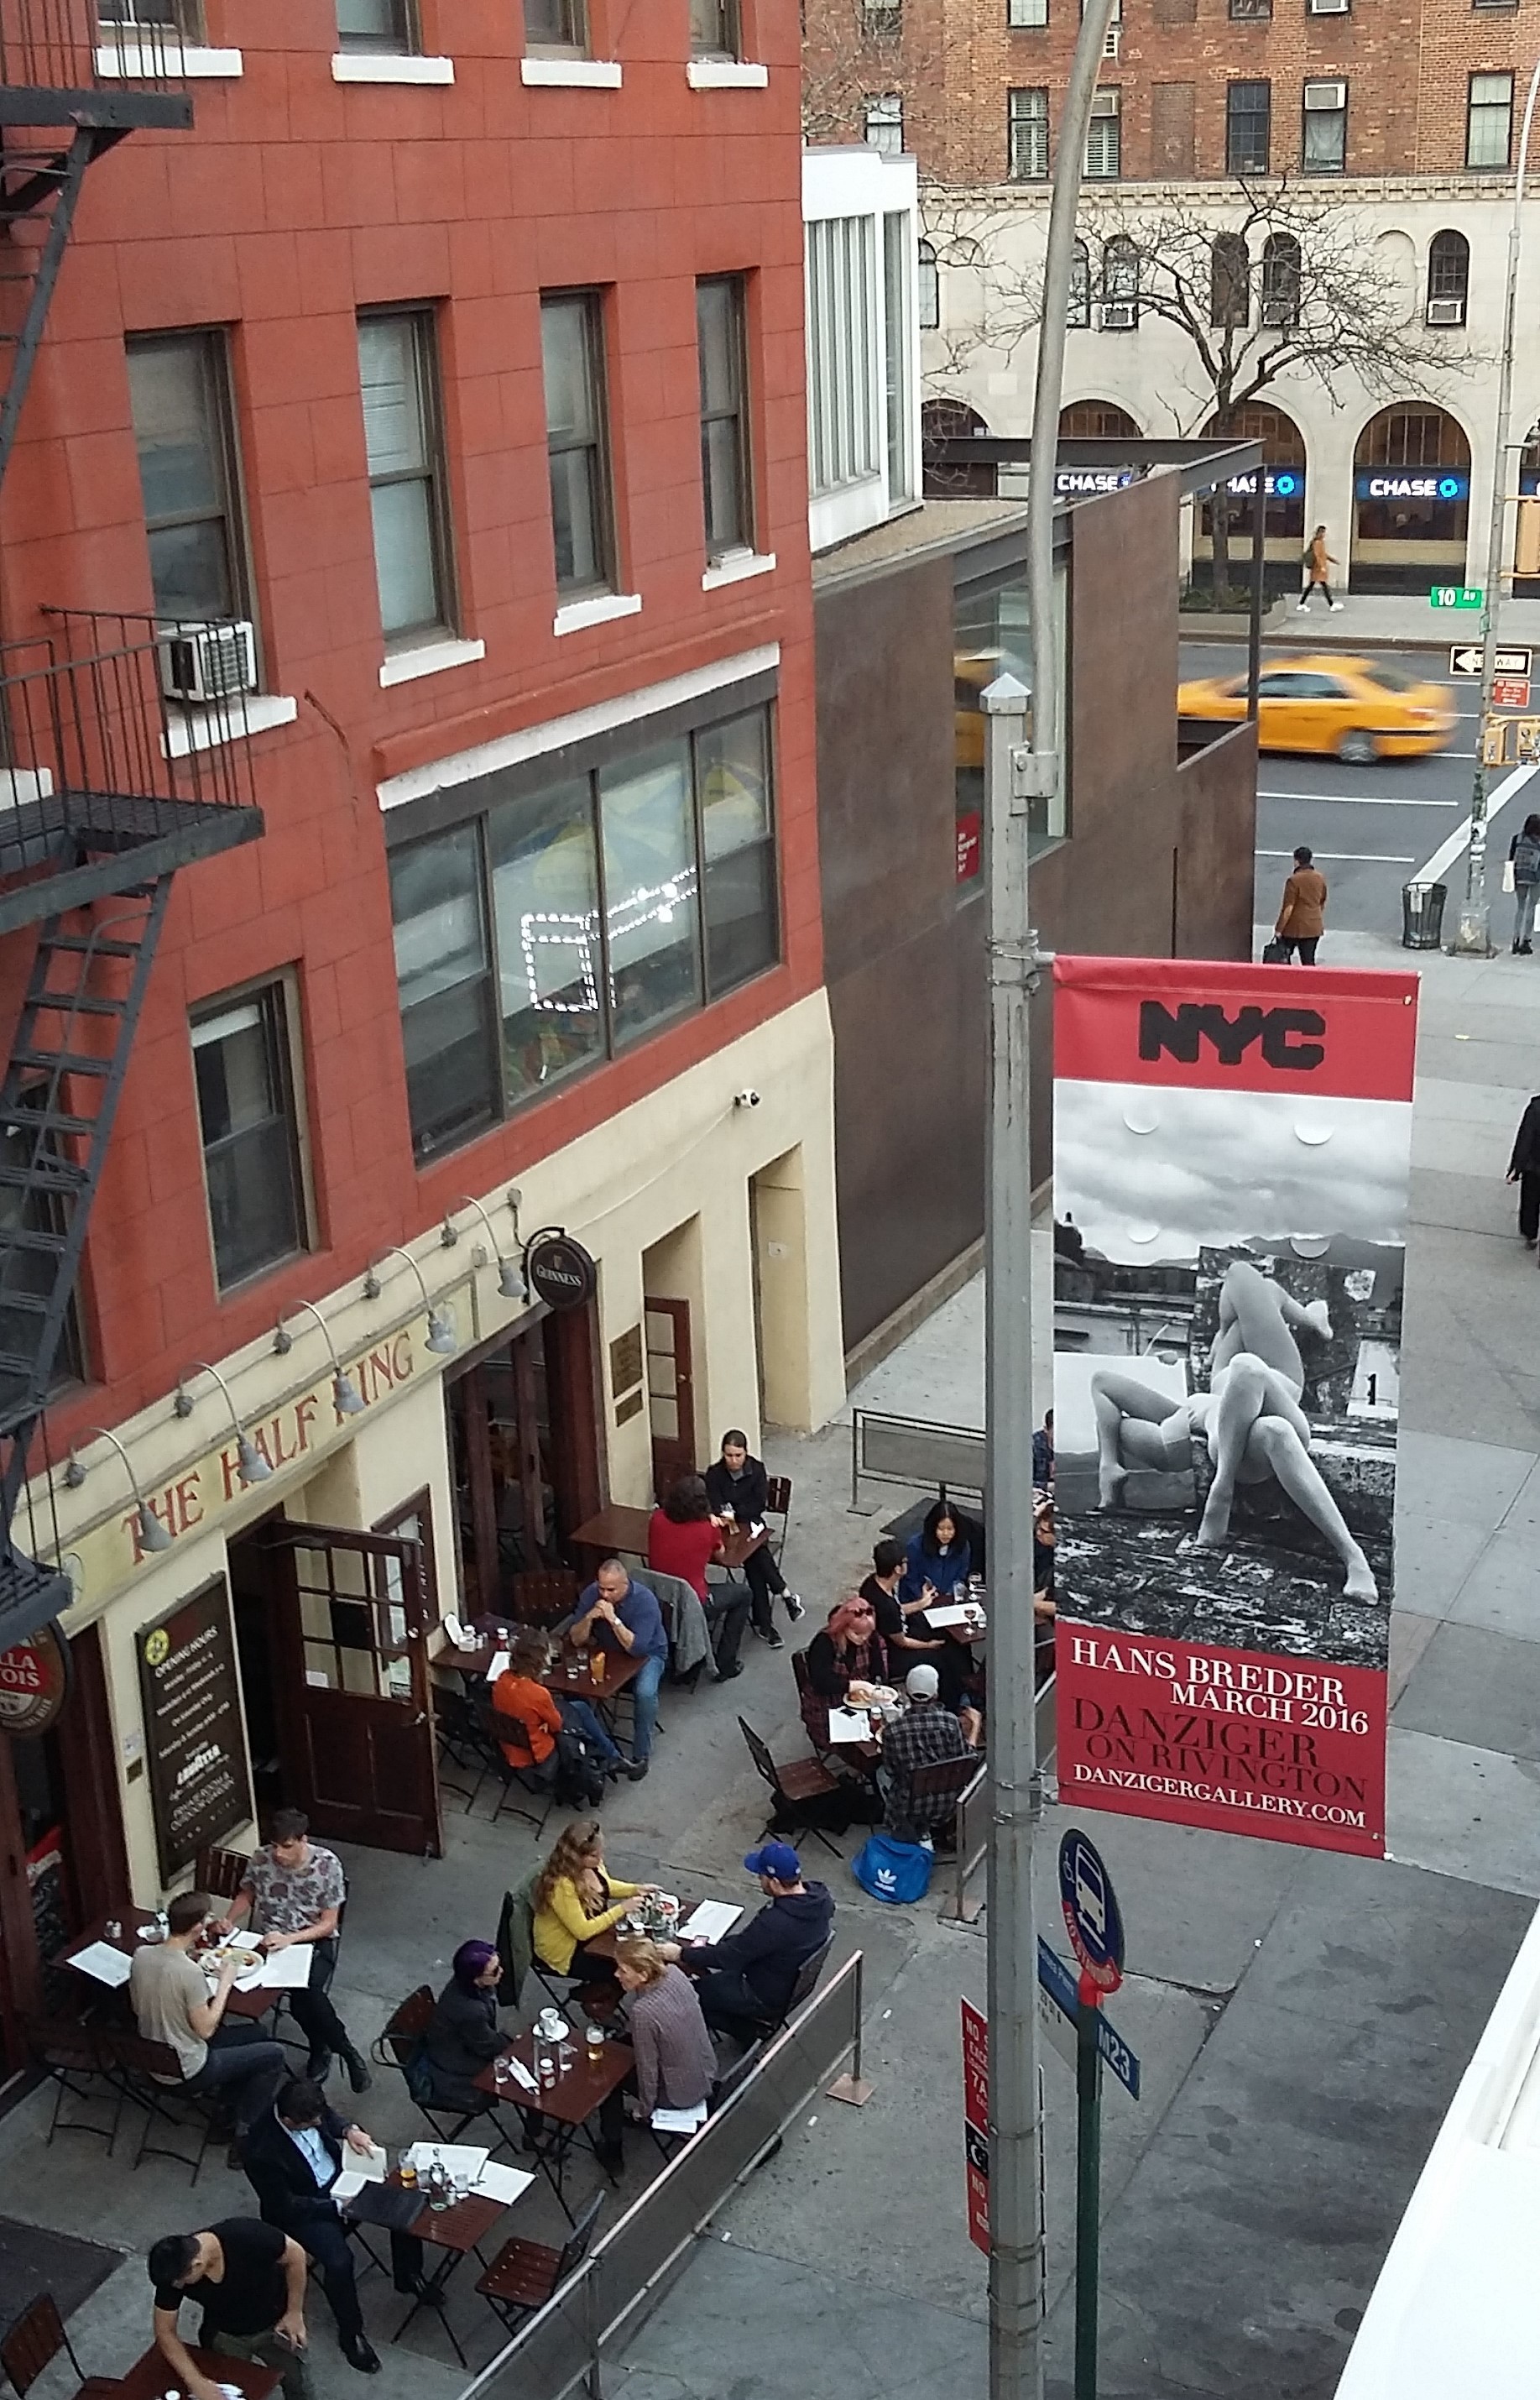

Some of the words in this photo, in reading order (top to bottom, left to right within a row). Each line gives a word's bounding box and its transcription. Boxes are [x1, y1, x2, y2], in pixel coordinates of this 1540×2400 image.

[1057, 474, 1118, 491] CHASE
[1210, 476, 1275, 494] HASE
[1370, 478, 1438, 497] CHASE
[1438, 589, 1456, 606] 10
[1496, 658, 1520, 667] WAY
[1139, 1000, 1326, 1070] NYC
[121, 1472, 204, 1565] THE
[221, 1394, 317, 1502] HALF
[1071, 1637, 1176, 1679] HANS
[1186, 1655, 1348, 1707] BREDER
[1073, 1697, 1320, 1768] DANZIGER
[1170, 1681, 1293, 1723] MARCH
[1301, 1702, 1369, 1735] 2016
[1085, 1733, 1136, 1764] ON
[1152, 1744, 1368, 1802] RIVINGTON
[1073, 1764, 1366, 1828] DANZIGERGALLERY.COM
[965, 2016, 979, 2042] NO
[1098, 2024, 1130, 2082] M23
